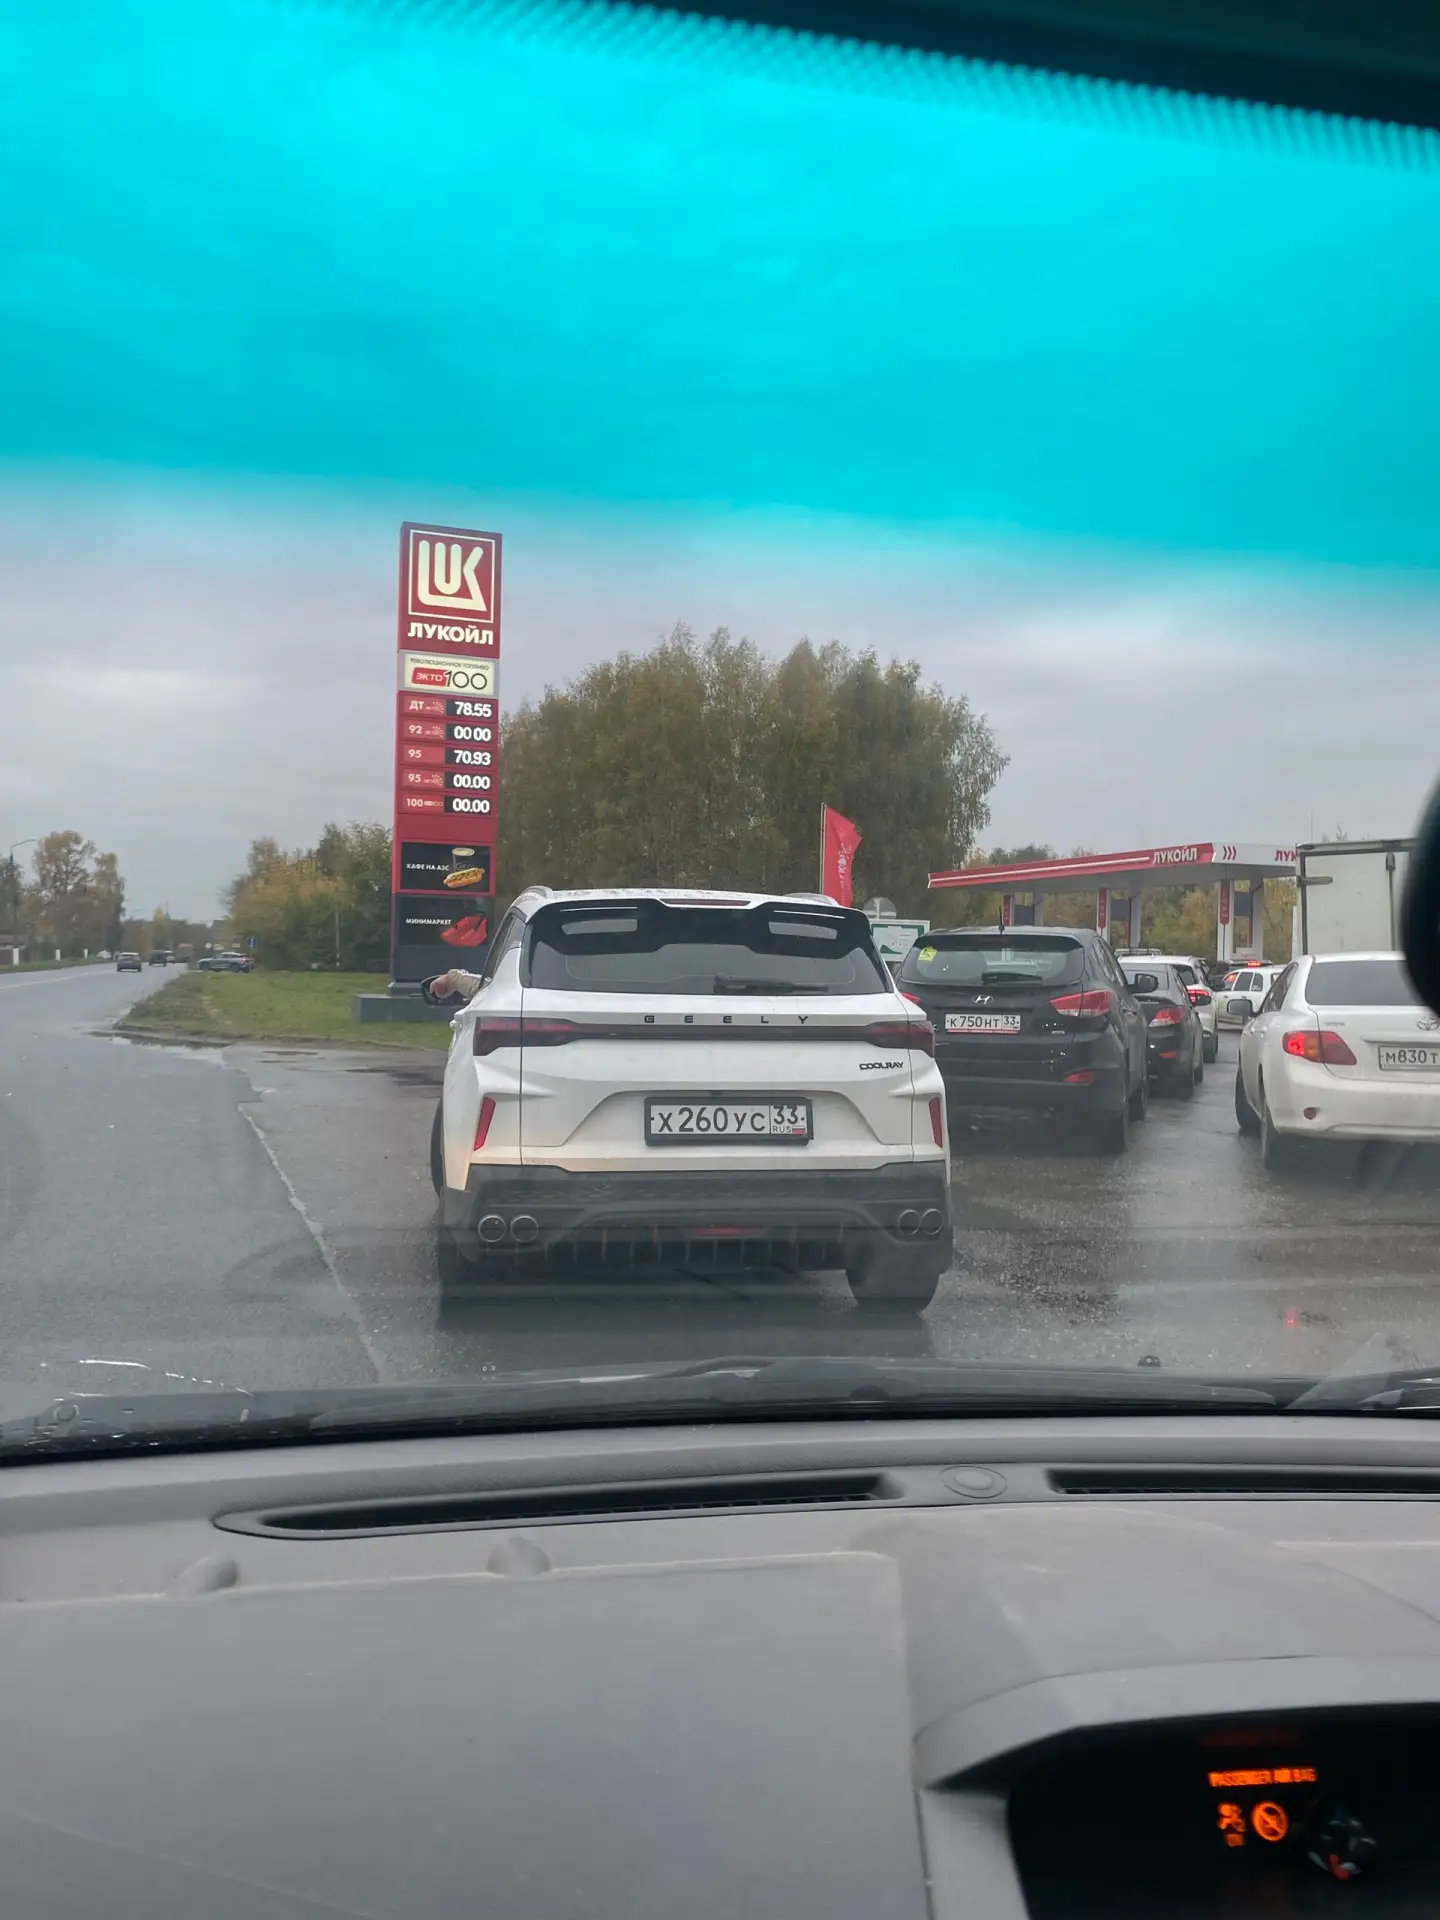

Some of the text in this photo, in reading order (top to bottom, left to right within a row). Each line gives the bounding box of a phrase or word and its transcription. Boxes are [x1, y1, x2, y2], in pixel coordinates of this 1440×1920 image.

[407, 622, 494, 646] ЛУКОЙЛ
[408, 700, 425, 712] ДТ
[454, 701, 493, 718] 78.55
[408, 724, 423, 735] 92
[408, 749, 491, 766] 95 70.93
[407, 773, 422, 783] 95
[453, 773, 491, 789] 00.00
[406, 798, 423, 808] 100
[452, 798, 490, 814] 00.00
[1152, 846, 1198, 865] ЛУКОЙЛ
[426, 863, 436, 871] НА
[436, 864, 451, 872] АЗС
[405, 917, 453, 926] МИНИМАРКЕТ
[643, 1014, 809, 1025] GEELY
[858, 1061, 904, 1071] COOLRAY
[772, 1125, 792, 1134] RUS
